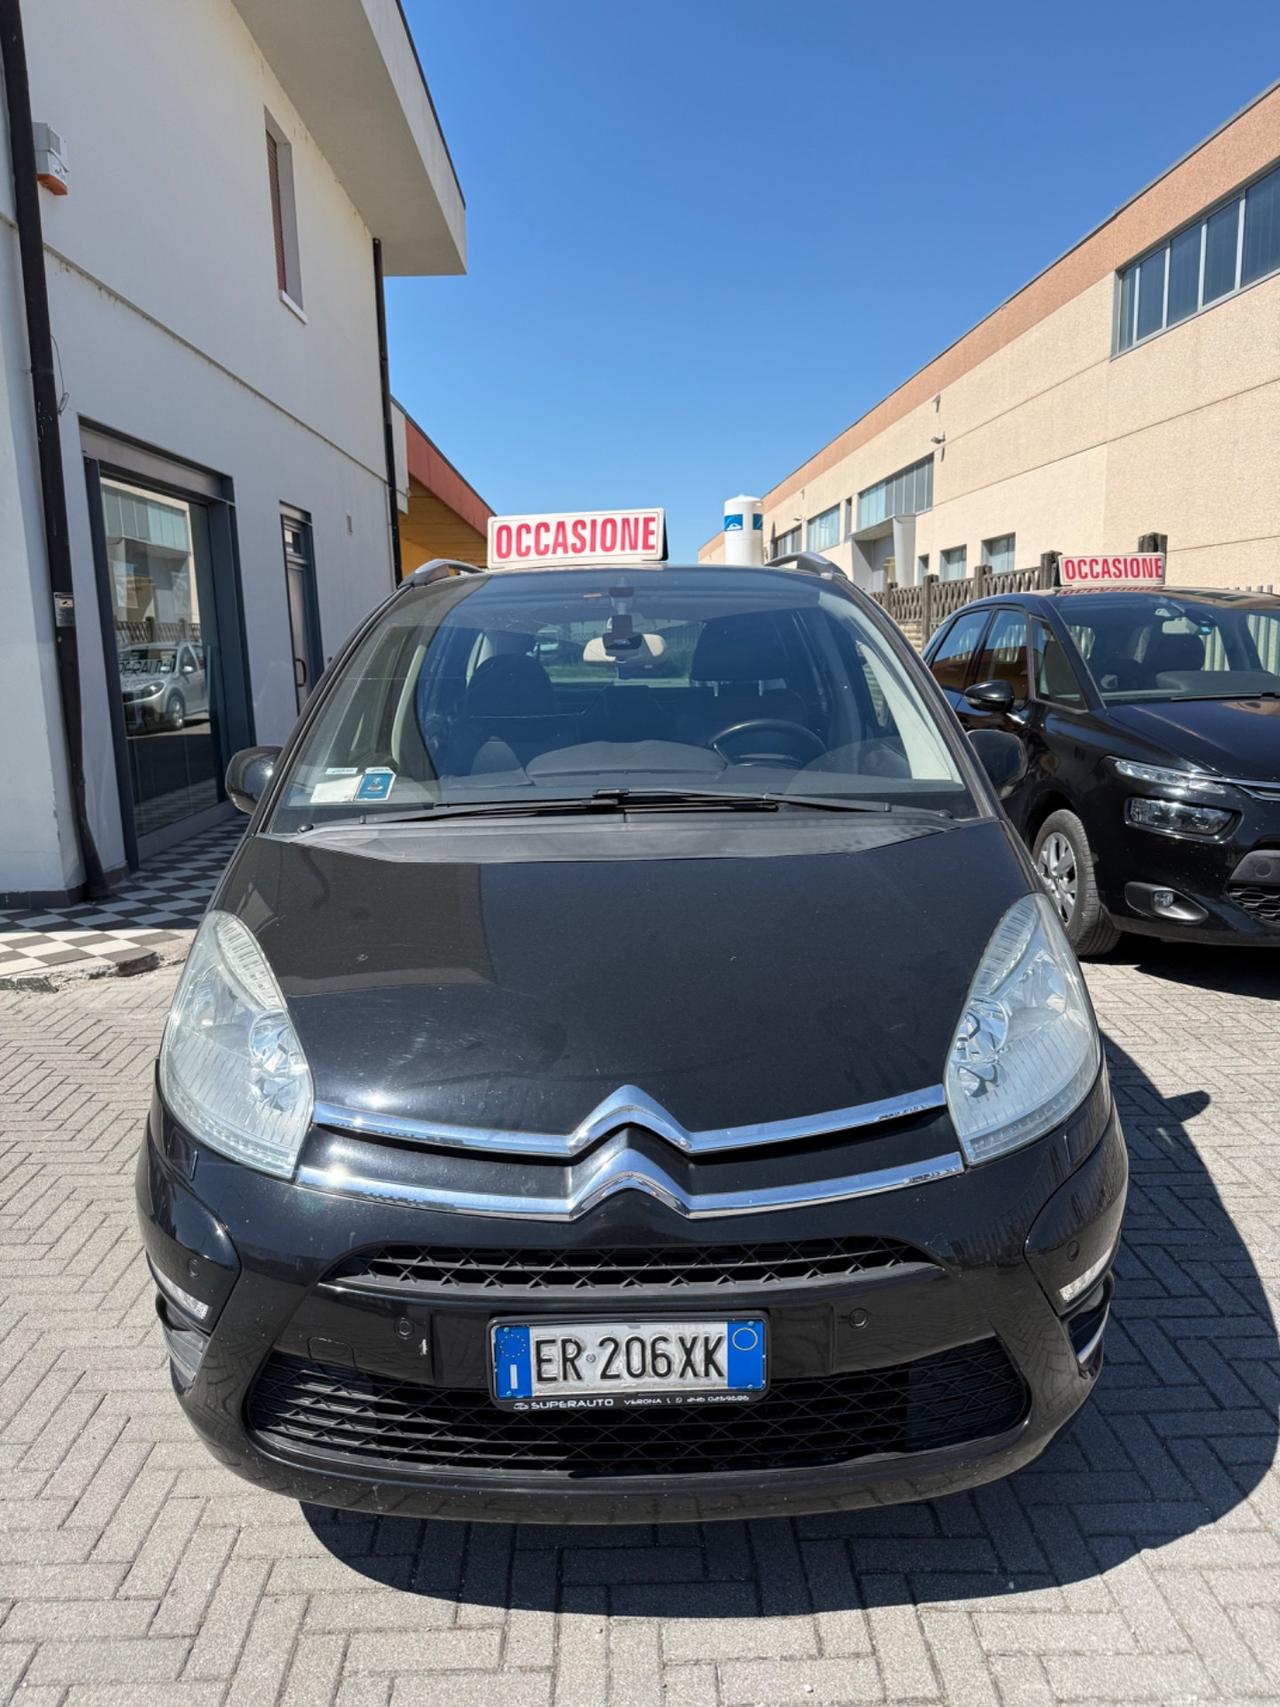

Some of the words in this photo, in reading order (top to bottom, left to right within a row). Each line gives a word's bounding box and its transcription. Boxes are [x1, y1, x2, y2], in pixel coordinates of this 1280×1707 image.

[495, 516, 656, 560] OCCASIONE
[1064, 557, 1163, 580] OCCASIONE
[535, 1338, 583, 1382] ER
[531, 1398, 614, 1410] SUPERAUTO
